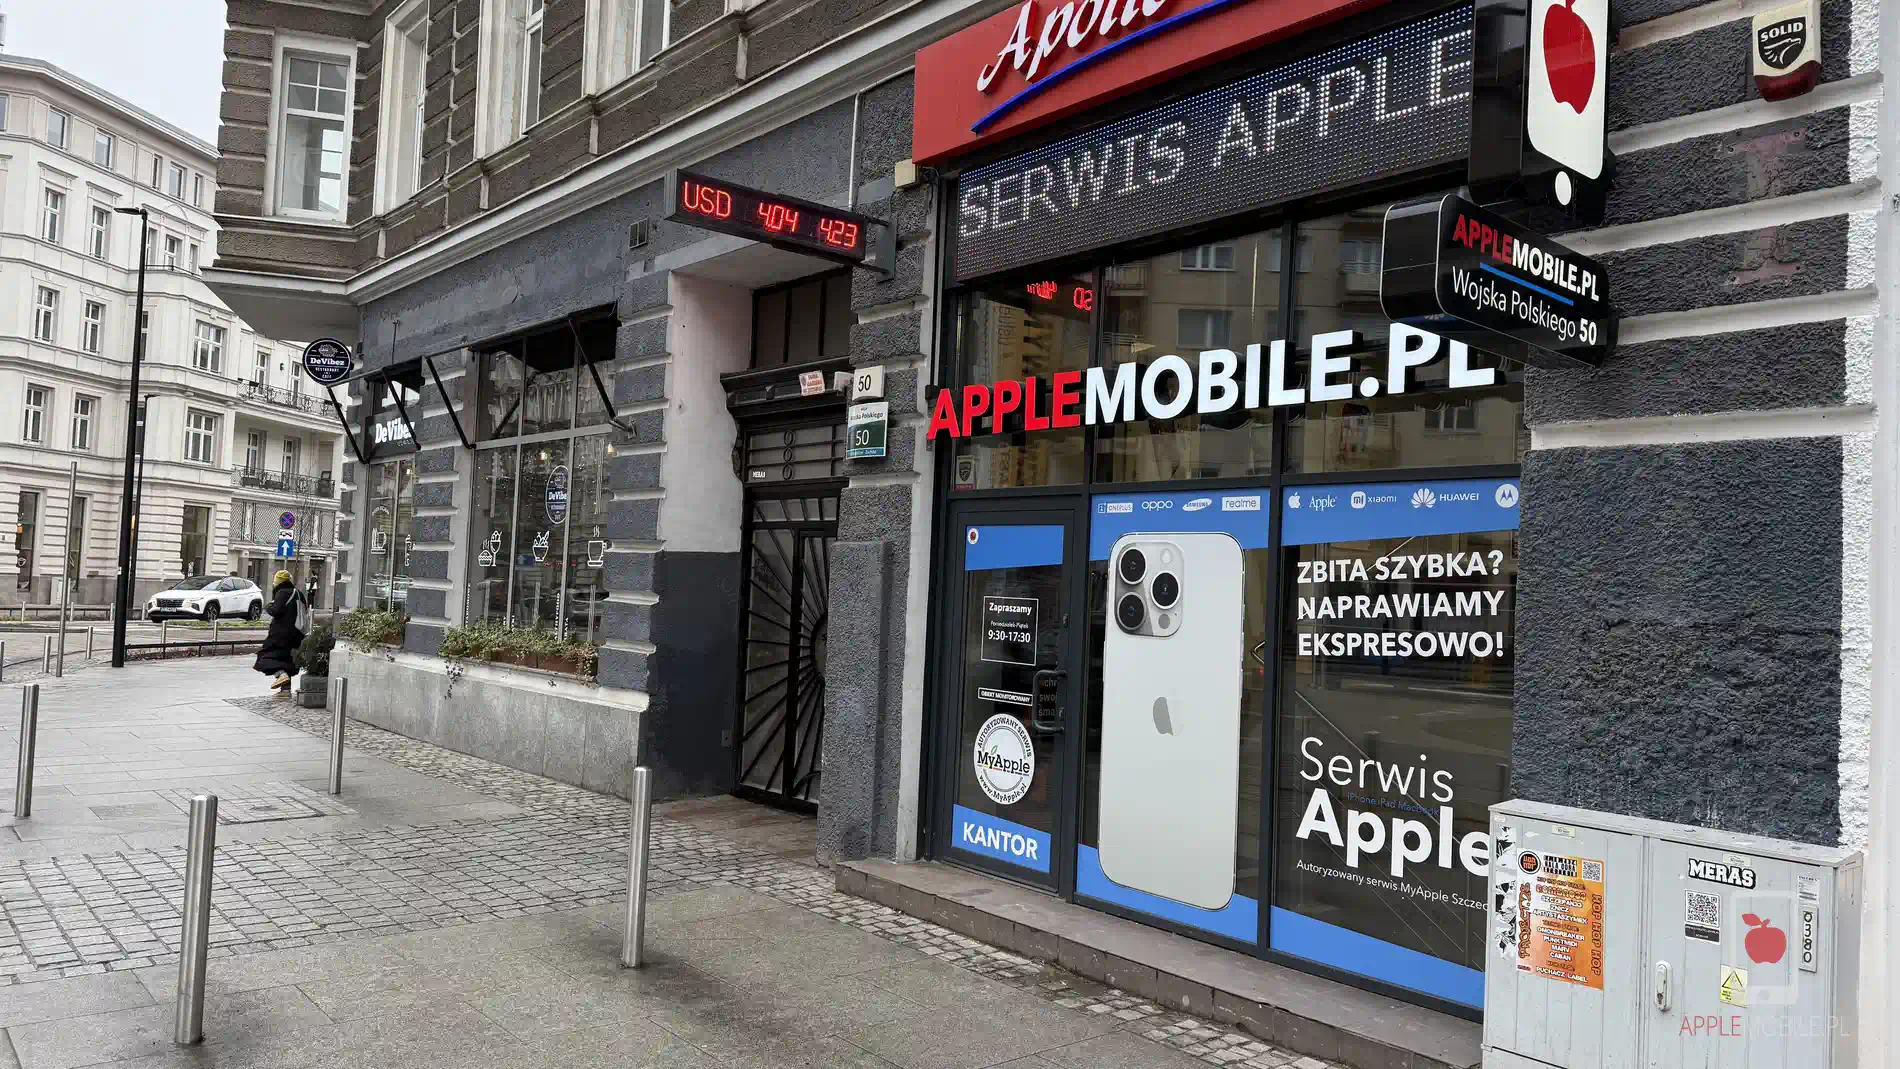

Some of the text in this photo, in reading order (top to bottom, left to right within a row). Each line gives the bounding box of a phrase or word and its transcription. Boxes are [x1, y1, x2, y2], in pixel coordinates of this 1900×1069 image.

[977, 0, 1167, 92] Apo
[1760, 22, 1803, 42] SOLID
[959, 29, 1473, 238] SERWIS APPLE
[684, 181, 731, 218] USD
[1453, 214, 1599, 302] APPLEMOBILE.PL
[1453, 266, 1597, 346] Wojska Polskiego 50
[857, 374, 872, 392] 50
[926, 322, 1495, 440] APPLEMOBILE.PL
[855, 429, 870, 446] 50
[548, 490, 567, 500] DeVibe
[1225, 498, 1257, 509] realme
[1309, 495, 1337, 512] Apple
[1439, 492, 1480, 502] HUAWEI
[1297, 550, 1504, 584] ZBITA SZYBKA?
[989, 602, 1032, 615] Zapraszamy
[1298, 590, 1505, 620] NAPRAWIAMY
[988, 629, 1031, 643] 9:30-17:30
[1299, 631, 1504, 657] EKSPRESOWO!
[978, 716, 1032, 757] AUTORYZOWANY SERWIS
[977, 750, 1031, 774] MyApple
[1300, 736, 1454, 803] Serwis
[979, 774, 1027, 803] www.MyApple.pl
[1347, 792, 1377, 805] iPhone
[1377, 798, 1397, 809] iPad
[963, 822, 1038, 861] KANTOR
[1296, 788, 1490, 878] Apple
[1296, 860, 1489, 911] Autoryzowany serwis MyApple Szczec
[1689, 858, 1755, 888] MERAS
[1591, 893, 1602, 976] HOP HOP HOP
[1803, 911, 1813, 963] 0380
[1536, 966, 1566, 978] PUCHACZ
[1567, 972, 1588, 983] LABEL
